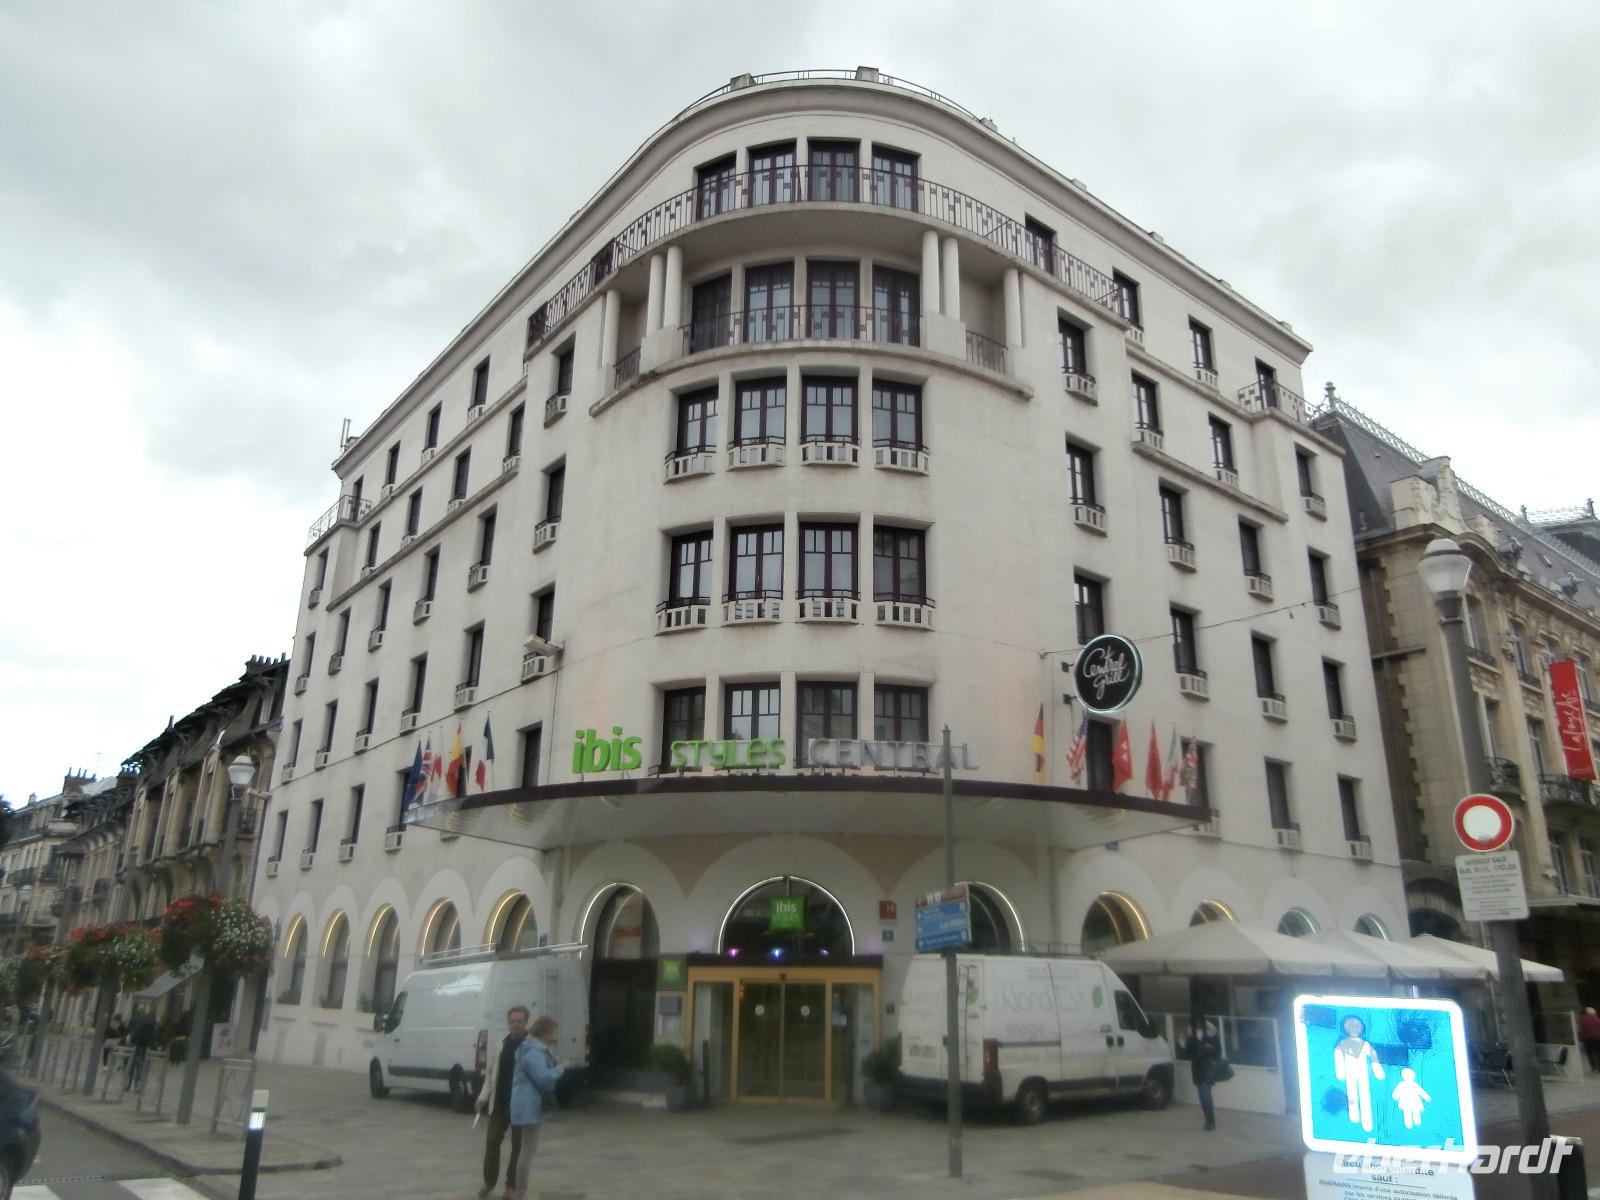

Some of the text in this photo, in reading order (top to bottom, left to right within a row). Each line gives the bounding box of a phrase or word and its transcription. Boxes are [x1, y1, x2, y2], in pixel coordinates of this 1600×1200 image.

[572, 726, 643, 774] ibis
[809, 738, 979, 770] CENTRAL
[776, 899, 797, 913] ibis
[1371, 1174, 1393, 1183] sauf
